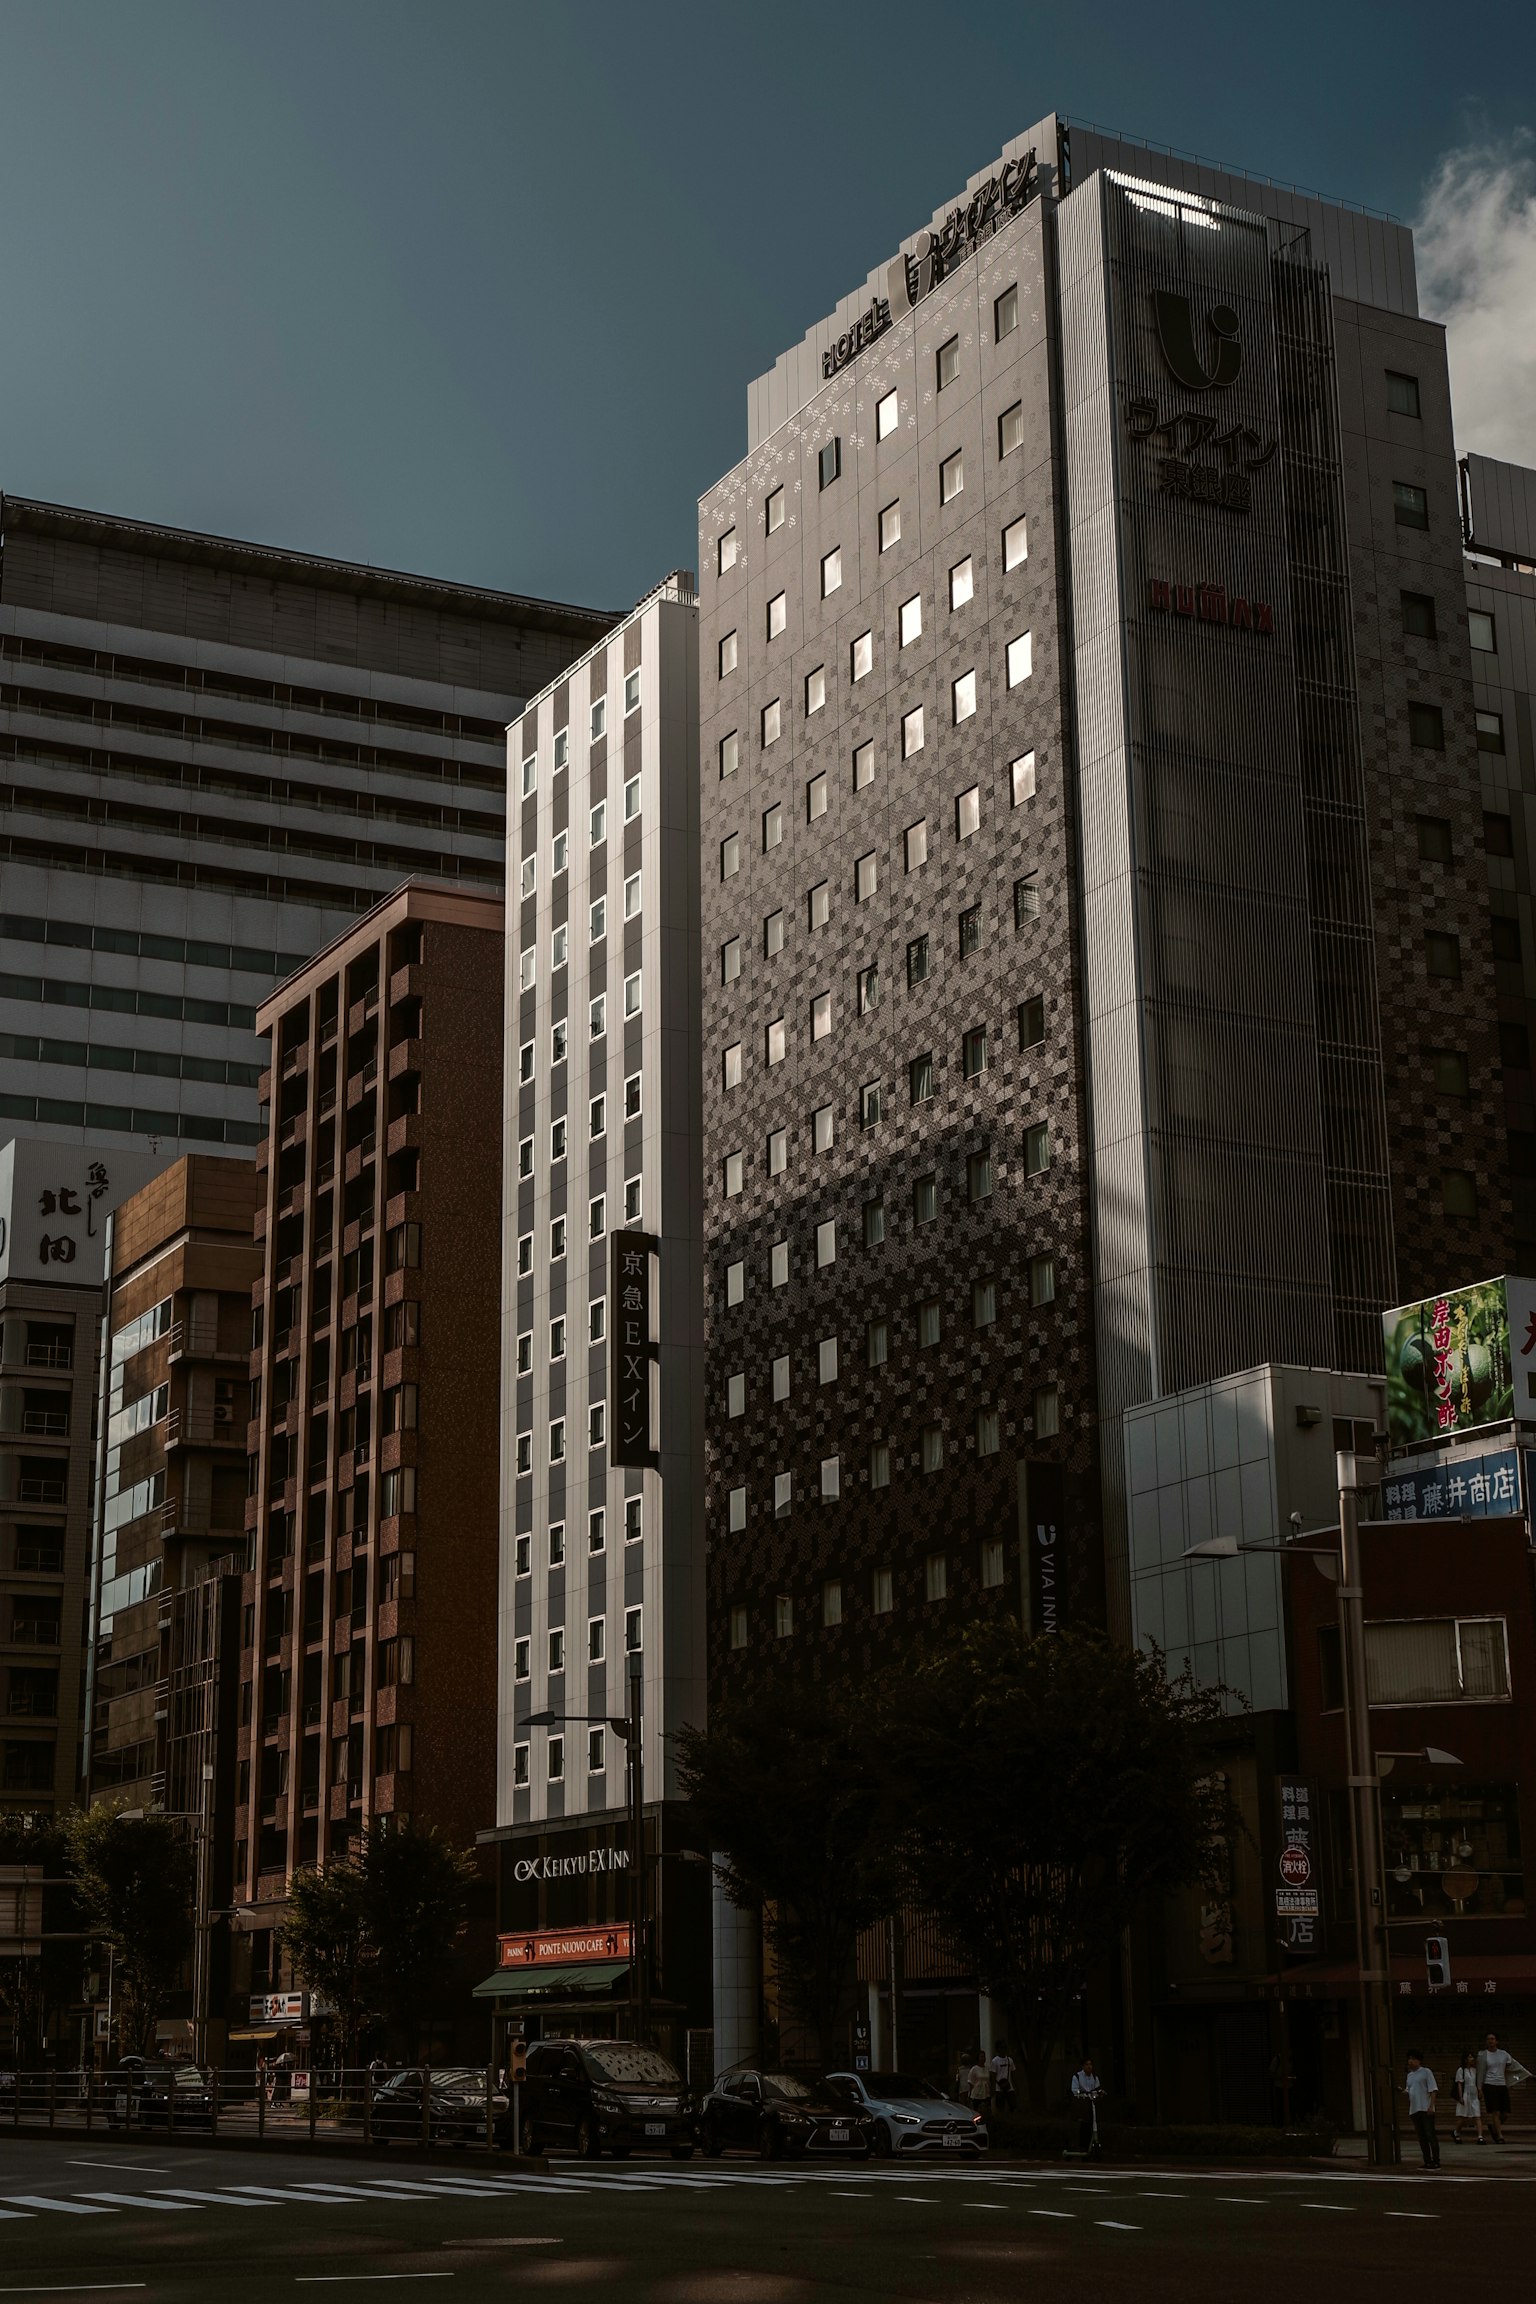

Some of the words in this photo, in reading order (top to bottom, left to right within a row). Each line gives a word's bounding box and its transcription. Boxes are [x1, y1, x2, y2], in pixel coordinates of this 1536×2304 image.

[822, 299, 888, 379] HOTEL
[1127, 397, 1278, 468] ヴィアイン
[1160, 456, 1252, 513] 東銀座
[621, 1249, 644, 1445] 京急EXイン
[1431, 1299, 1459, 1430] 岸田ポン酢
[1421, 1467, 1515, 1516] 藤井商店
[1040, 1553, 1056, 1590] VIA
[1041, 1596, 1057, 1634] INN
[588, 1849, 607, 1873] EX
[1282, 1859, 1308, 1875] 消火栓
[539, 1943, 561, 1956] PONTE
[561, 1941, 586, 1954] NUOVO
